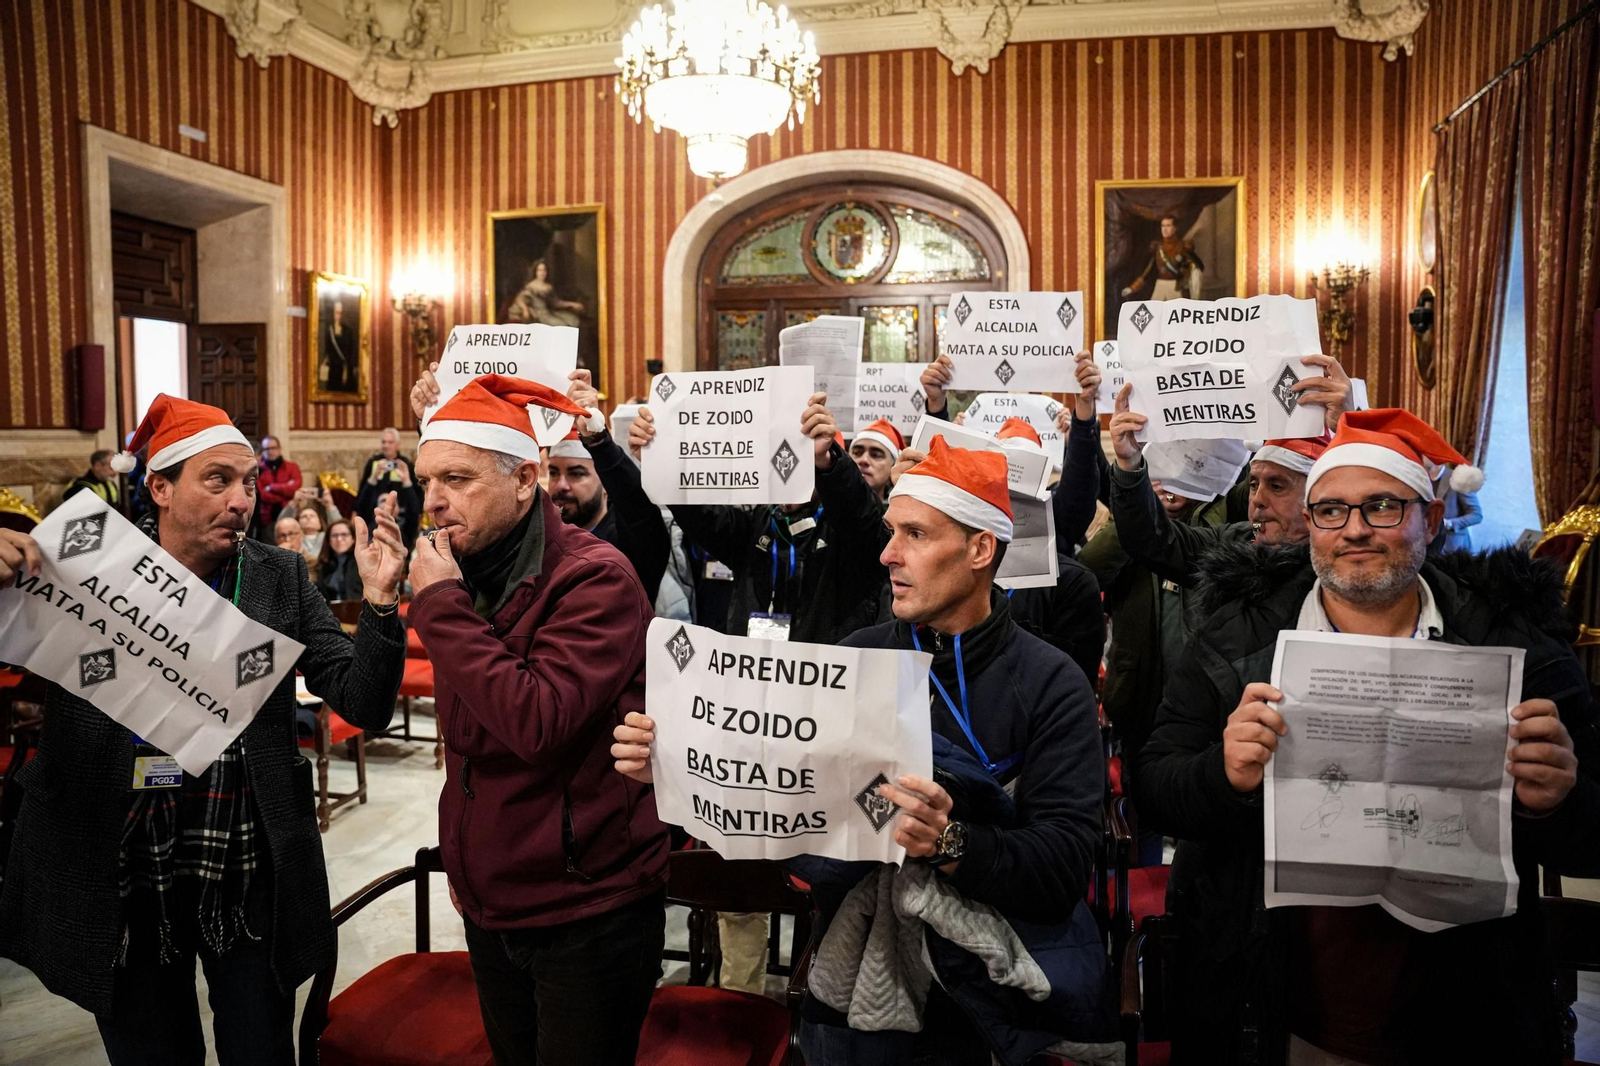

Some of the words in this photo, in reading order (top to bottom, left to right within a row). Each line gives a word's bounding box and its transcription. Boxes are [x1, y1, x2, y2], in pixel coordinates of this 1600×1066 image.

[989, 299, 1020, 310] ESTA
[1167, 305, 1261, 325] APRENDIZ
[975, 321, 1038, 333] ALCALDIA
[466, 333, 531, 346] APRENDIZ
[947, 344, 985, 356] MATA
[988, 345, 998, 356] A
[1001, 345, 1019, 356] SU
[1023, 345, 1074, 357] POLICIA
[1153, 341, 1176, 358] DE
[1182, 338, 1245, 356] ZOIDO
[454, 361, 470, 374] DE
[474, 361, 518, 375] ZOIDO
[866, 368, 883, 376] RPT
[690, 378, 765, 395] APRENDIZ
[1156, 370, 1215, 391] BASTA
[1219, 369, 1245, 385] DE
[859, 384, 877, 392] ICIA
[880, 384, 909, 393] LOCAL
[859, 400, 876, 408] MO
[878, 400, 896, 409] QUE
[994, 398, 1018, 407] ESTA
[678, 411, 700, 425] DE
[706, 410, 753, 425] ZOIDO
[859, 412, 879, 421] ARÍA
[983, 414, 1031, 424] ALCAIA
[1163, 403, 1256, 423] MENTIRAS
[679, 442, 734, 455] BASTA
[737, 440, 754, 455] DE
[680, 471, 759, 486] MENTIRAS
[132, 555, 189, 607] ESTA
[79, 575, 192, 661] ALCALDIA
[89, 618, 107, 635] A
[111, 632, 145, 657] SU
[147, 656, 230, 724] POLICIA
[708, 649, 847, 690] APRENDIZ
[692, 695, 716, 725] DE
[722, 706, 818, 742] ZOIDO
[687, 747, 768, 786] BASTA
[777, 767, 815, 789] DE
[152, 776, 174, 785] PG02
[692, 794, 827, 835] MENTIRAS
[1363, 808, 1406, 818] SPLS
